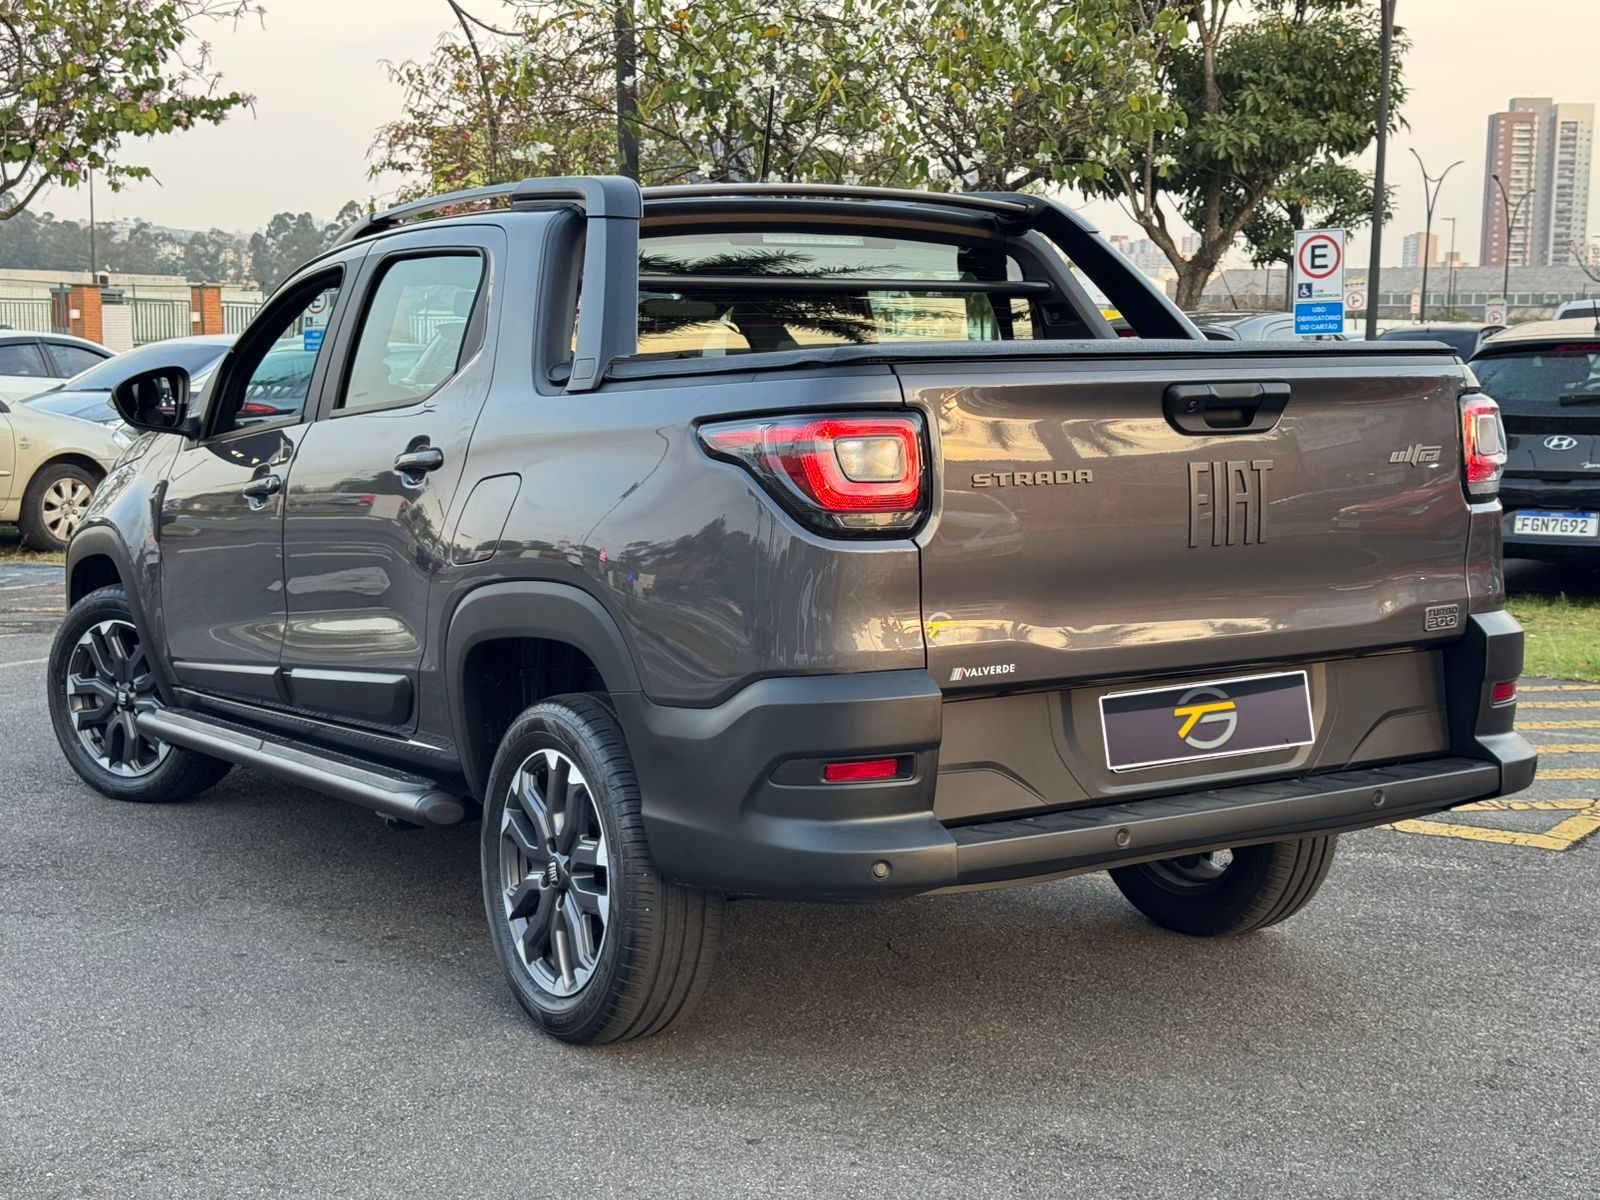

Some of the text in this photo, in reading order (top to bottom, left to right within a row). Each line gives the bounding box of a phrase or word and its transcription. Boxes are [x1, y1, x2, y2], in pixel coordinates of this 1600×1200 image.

[1310, 244, 1328, 269] E
[1310, 322, 1338, 330] CARTÃO
[971, 469, 1093, 488] STRADA
[1187, 460, 1273, 548] FIAT
[1521, 517, 1588, 533] FGN7G92
[1428, 607, 1457, 616] TURBO
[1428, 616, 1456, 627] 200
[964, 664, 1016, 678] VALVERDE
